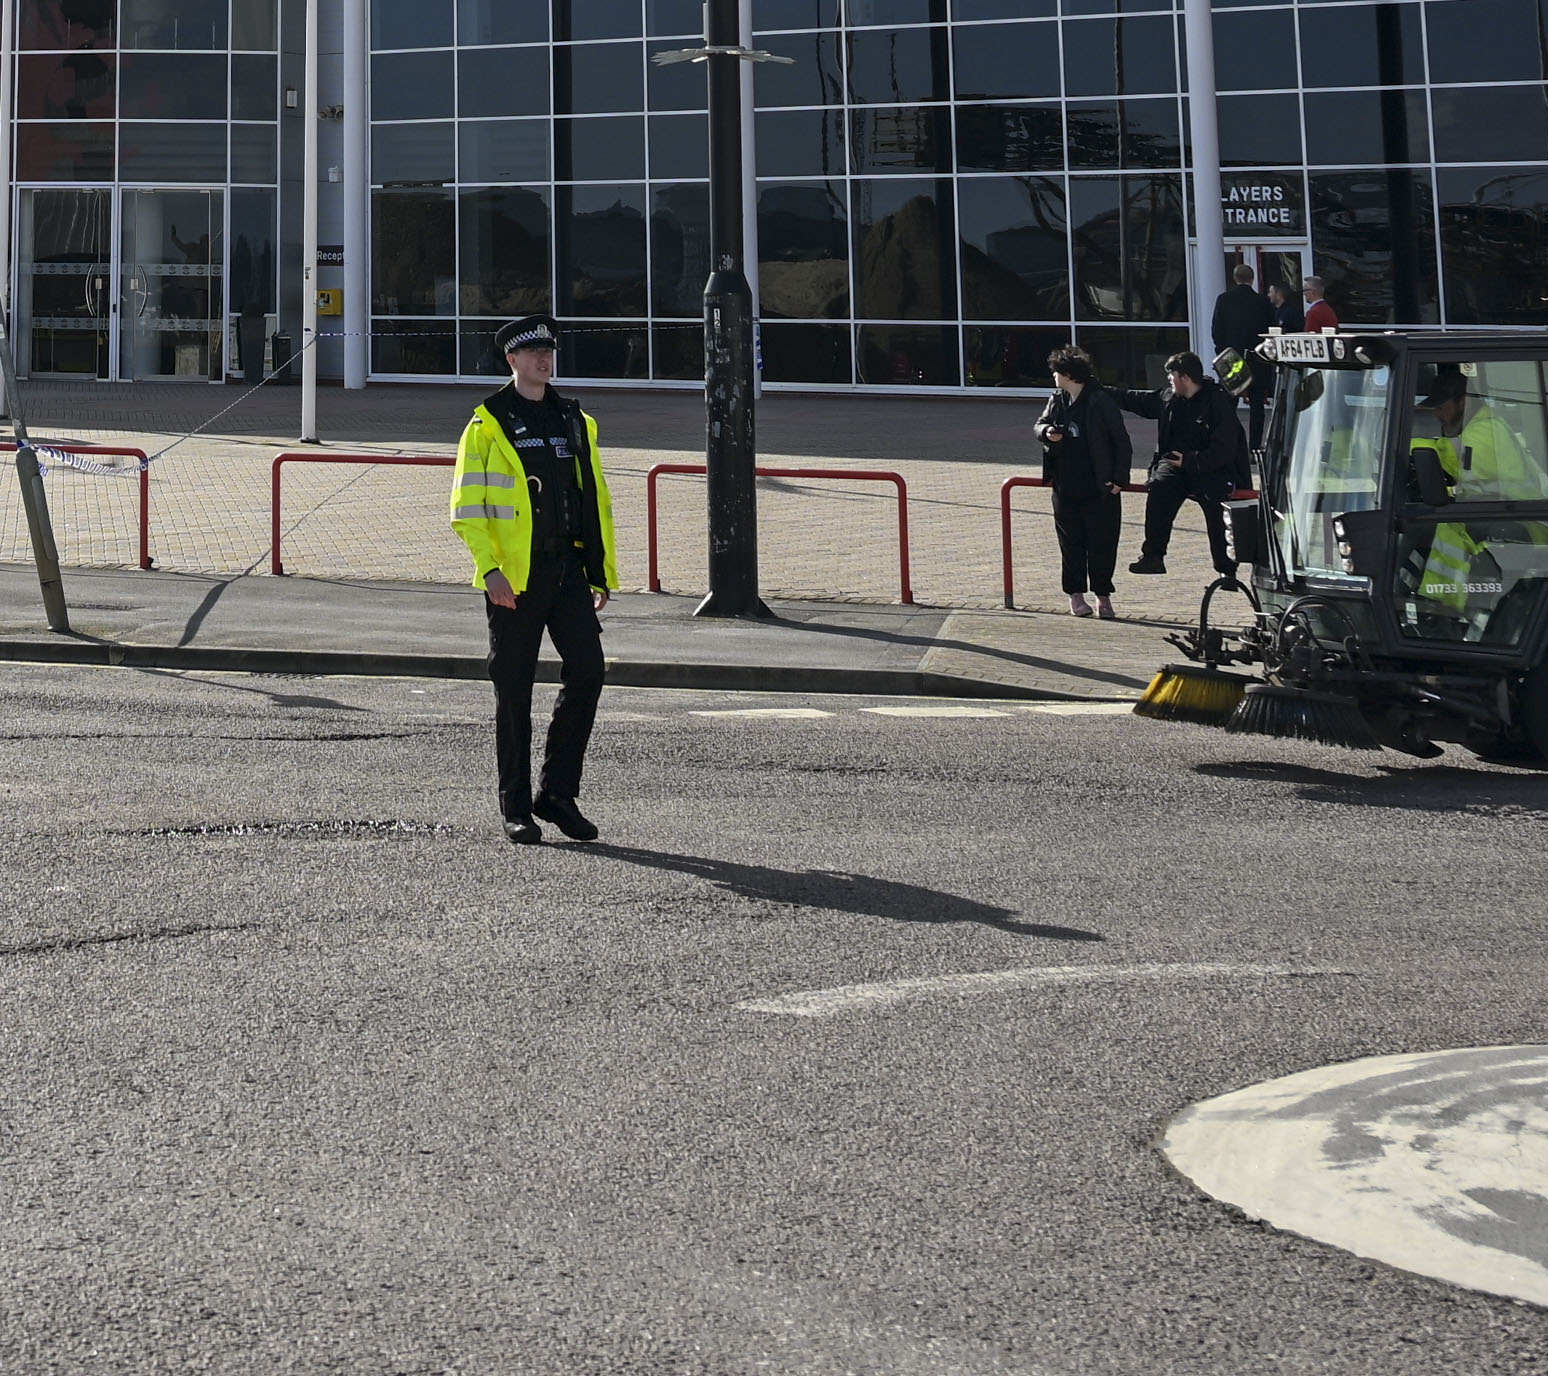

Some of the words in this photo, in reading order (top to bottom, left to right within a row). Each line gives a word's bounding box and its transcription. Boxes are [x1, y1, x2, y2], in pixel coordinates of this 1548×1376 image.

[1221, 186, 1283, 202] LAYERS
[1223, 208, 1291, 224] TRANCE
[317, 250, 344, 262] Recept
[1280, 339, 1304, 359] AF64
[1305, 340, 1325, 360] FLB
[1425, 583, 1458, 594] 01733
[1462, 582, 1503, 593] 363393
